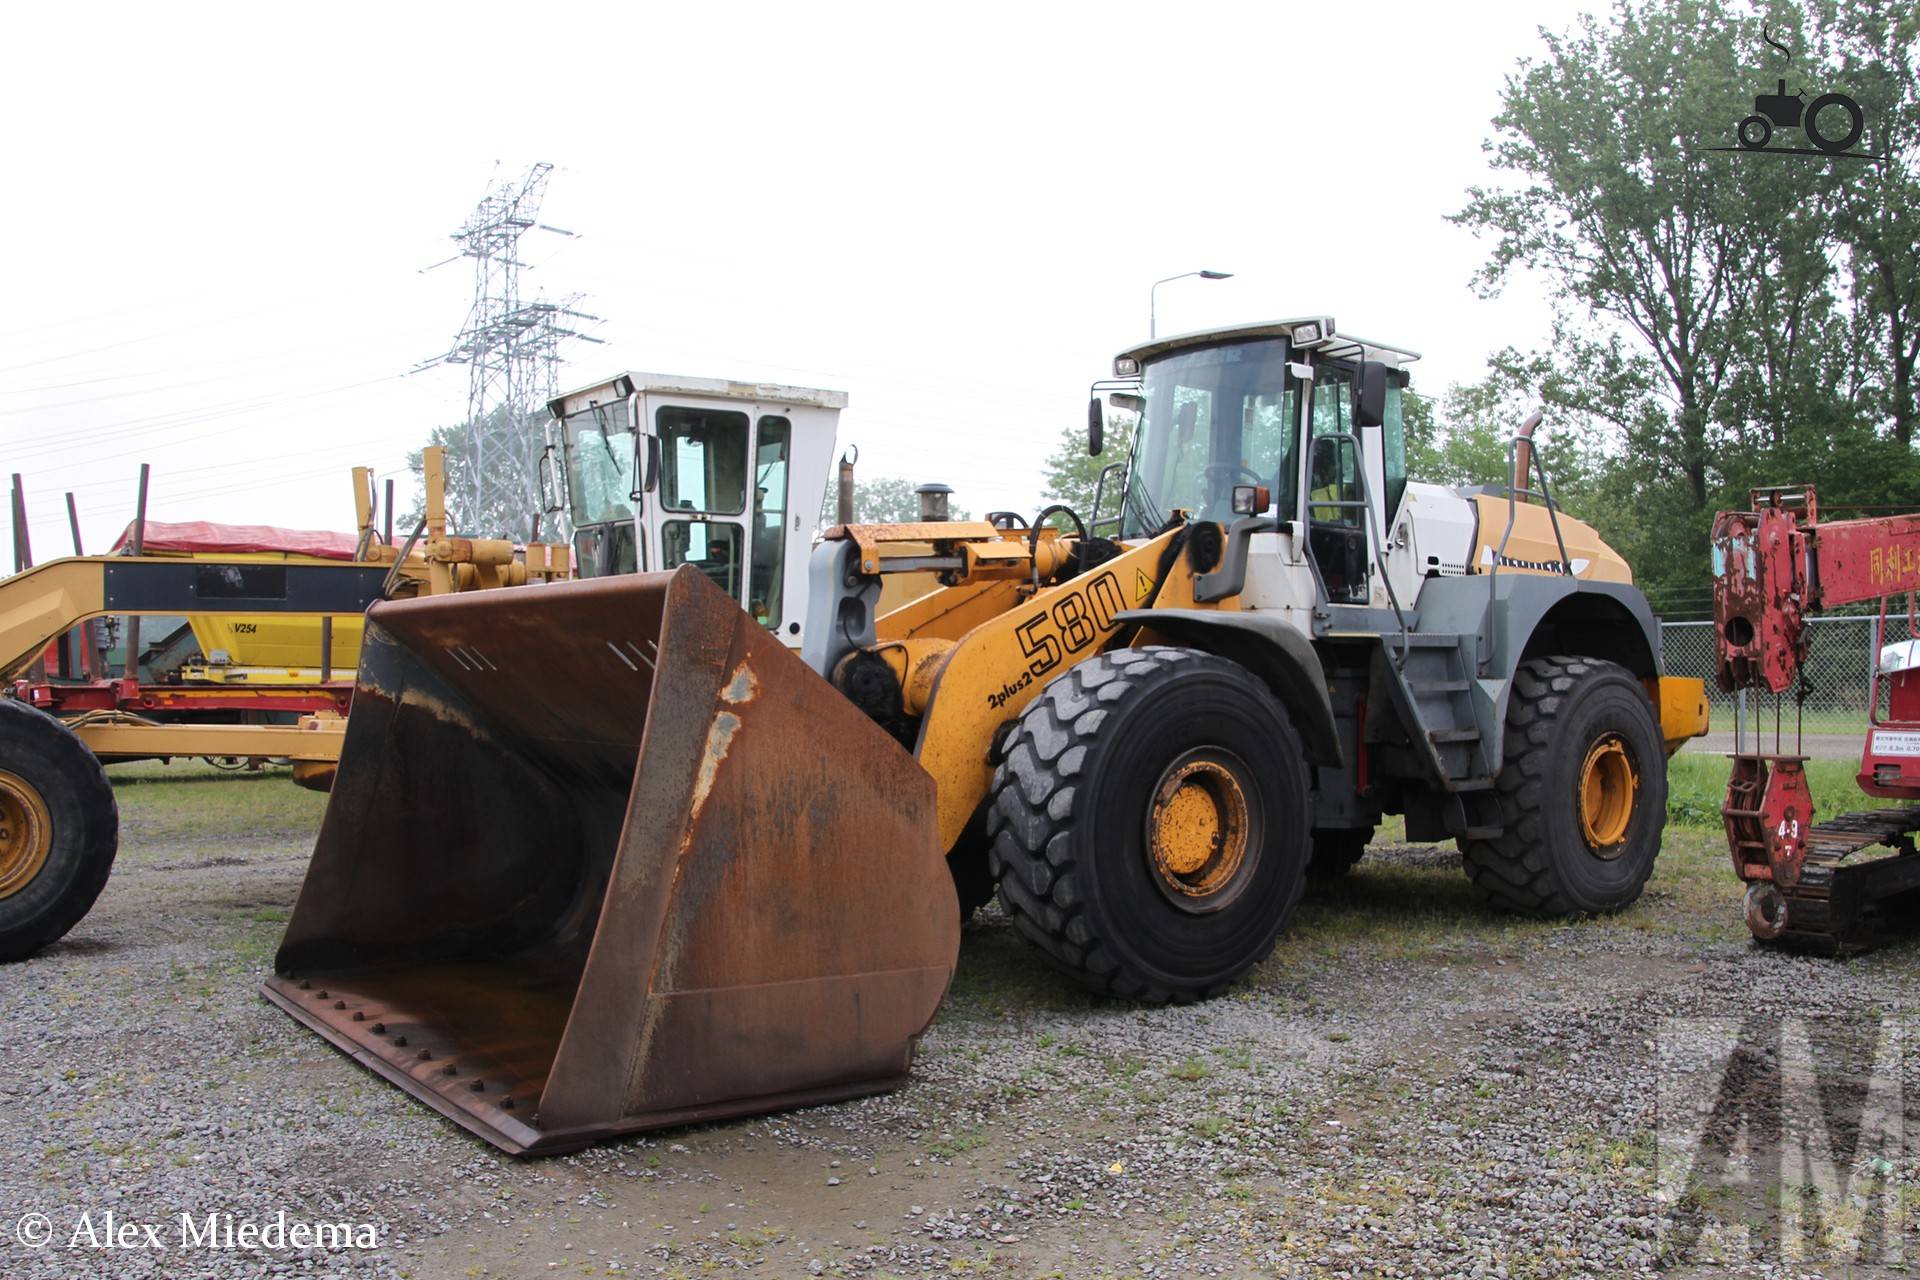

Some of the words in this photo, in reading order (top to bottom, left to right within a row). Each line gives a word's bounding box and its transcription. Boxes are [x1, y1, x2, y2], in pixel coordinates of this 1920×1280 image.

[1870, 543, 1920, 586] 同利工
[235, 623, 257, 634] V254
[1014, 571, 1127, 677] 580
[987, 671, 1033, 710] 2plus2
